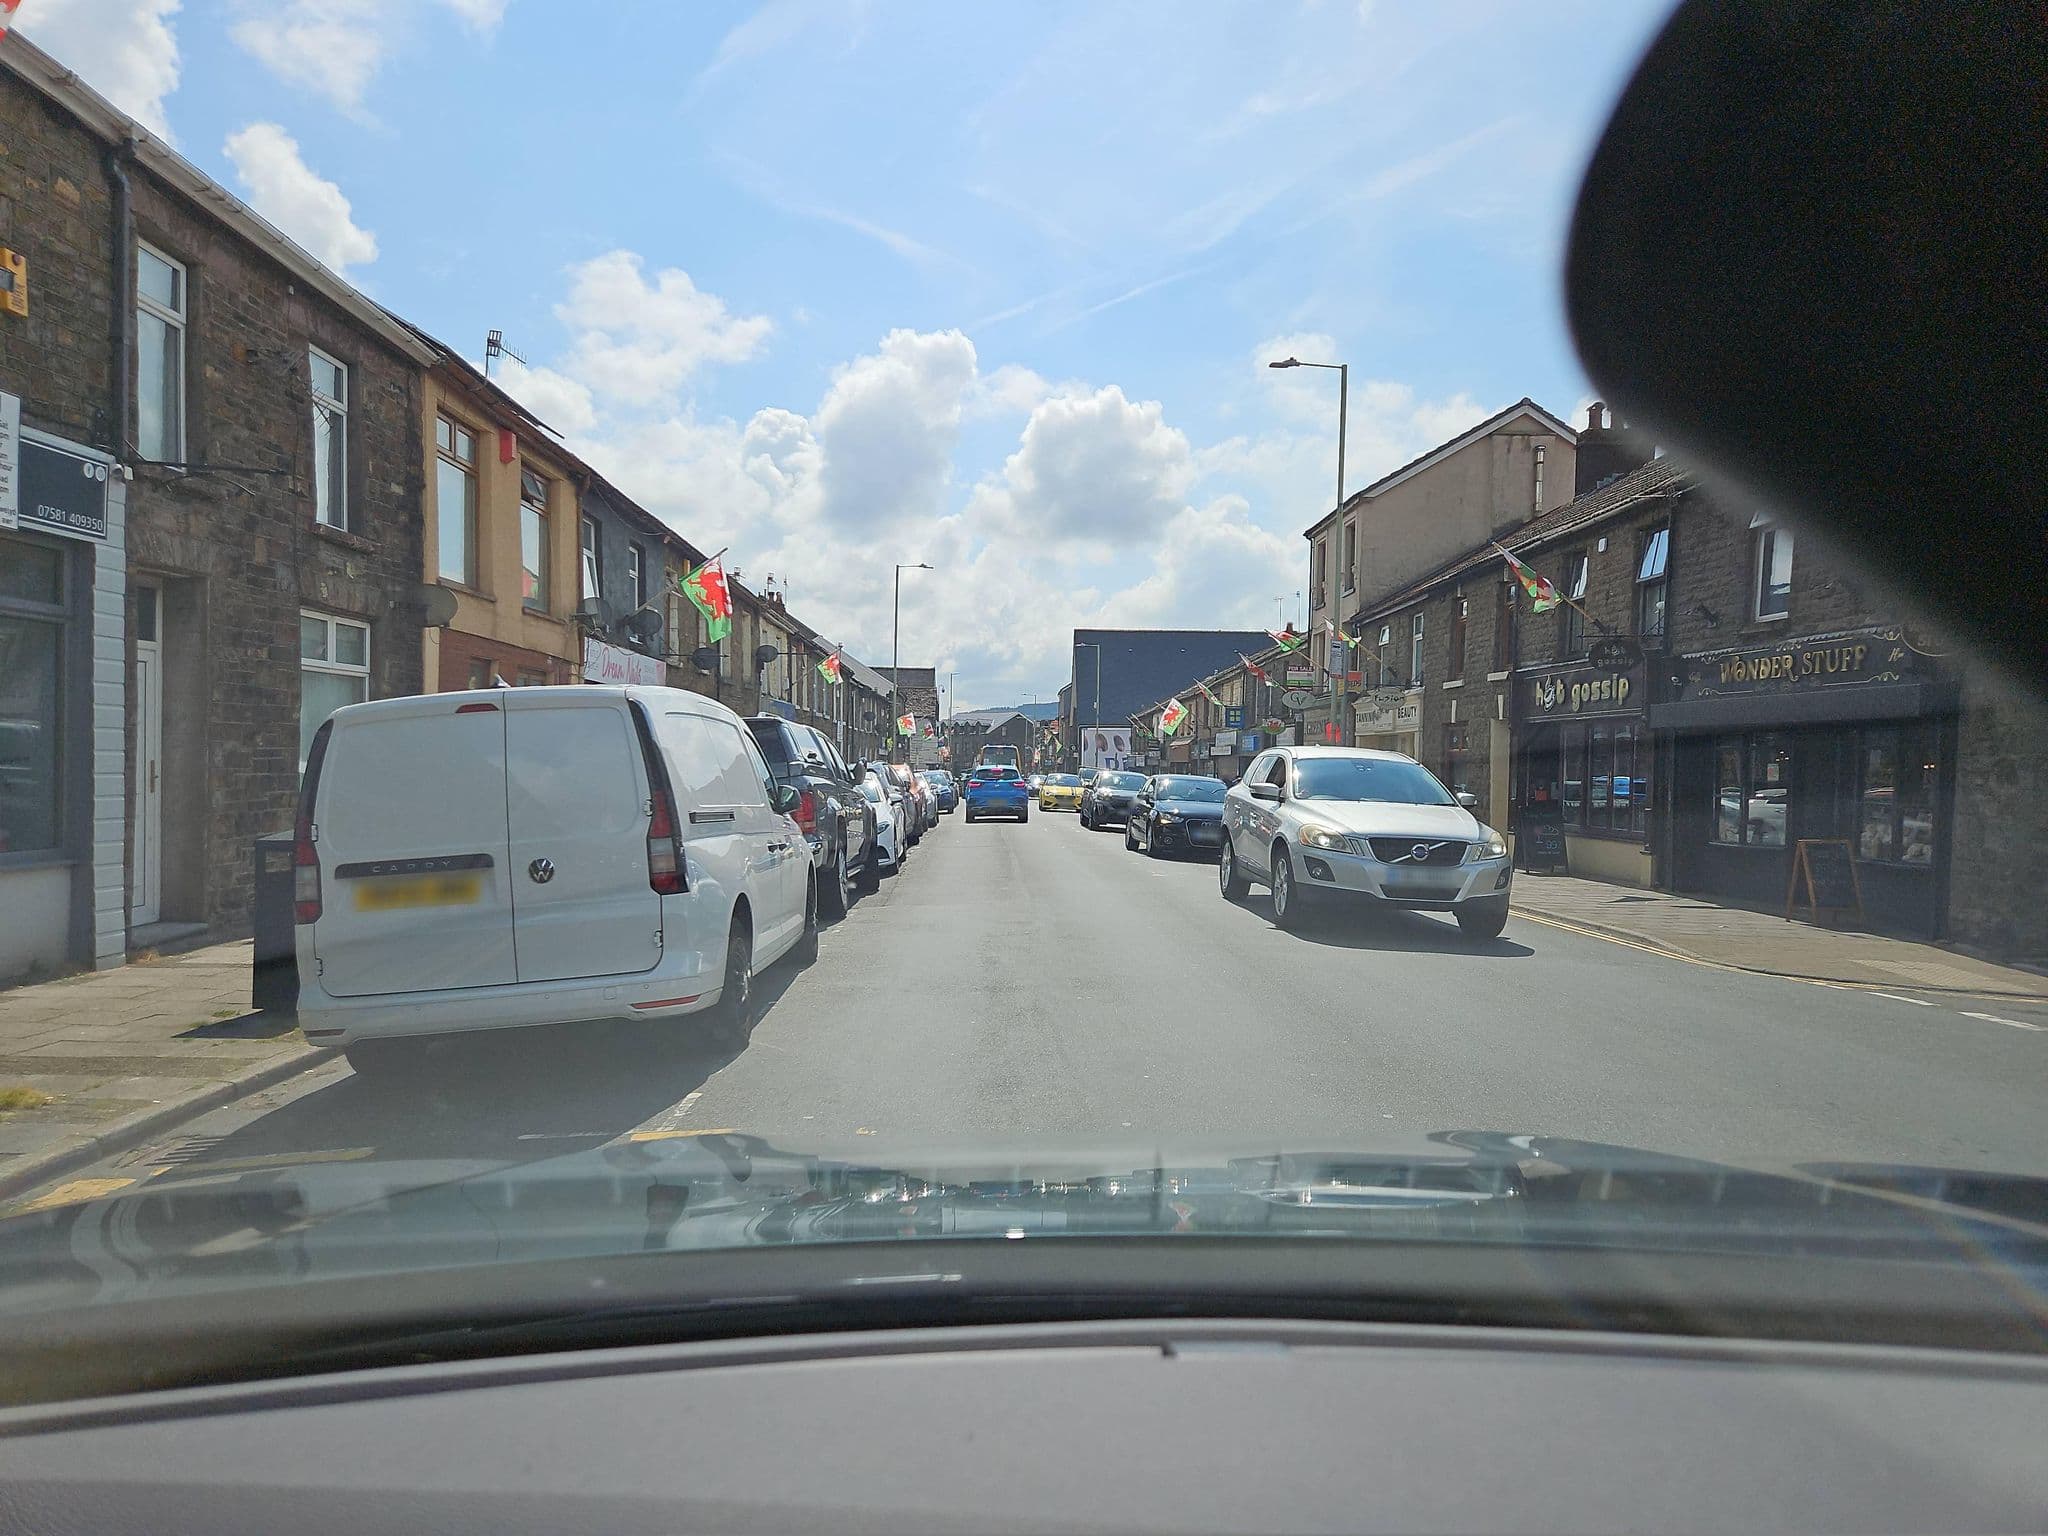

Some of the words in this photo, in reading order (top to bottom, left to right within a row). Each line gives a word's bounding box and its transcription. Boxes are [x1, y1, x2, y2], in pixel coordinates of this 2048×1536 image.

[38, 504, 66, 521] 07581
[69, 513, 103, 531] 409350
[1720, 654, 1800, 683] WONDER
[1801, 644, 1868, 675] STUFF
[1571, 674, 1629, 712] gossip
[1398, 706, 1417, 719] BEAUTY
